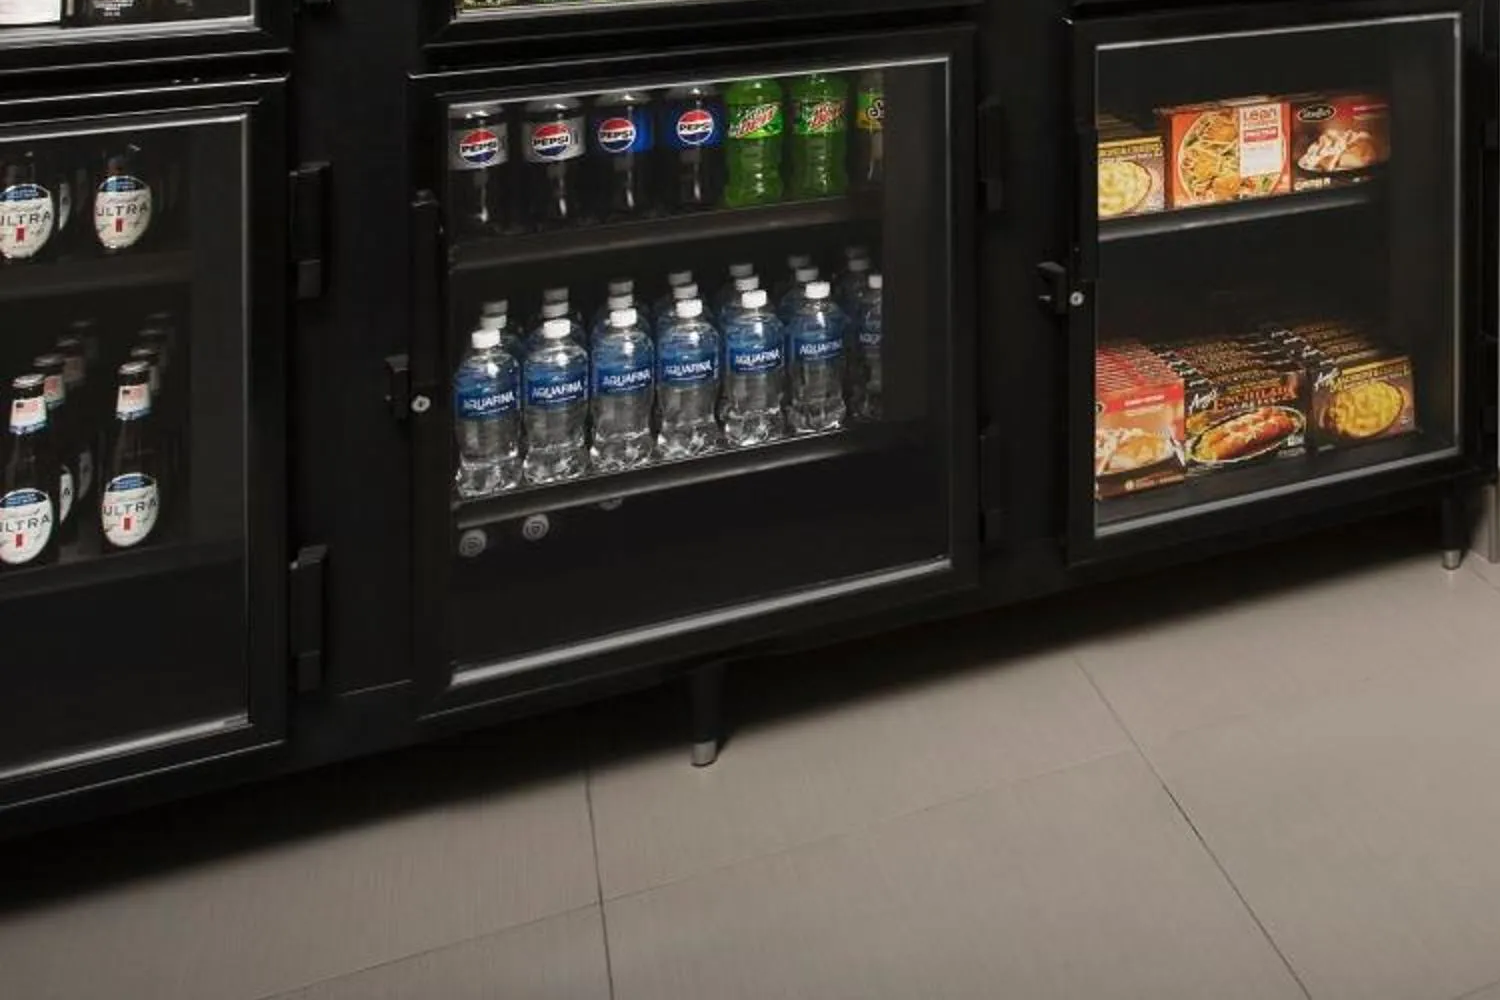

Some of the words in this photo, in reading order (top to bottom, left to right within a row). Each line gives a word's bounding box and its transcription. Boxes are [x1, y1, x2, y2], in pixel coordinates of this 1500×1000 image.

[533, 135, 569, 147] PEPSI
[96, 201, 148, 217] ULTRA
[800, 340, 843, 355] AQUAFINA
[735, 348, 781, 366] AQUAFINA
[665, 359, 712, 376] AQUAFINA
[602, 368, 651, 388] AQUAFINA
[531, 380, 583, 399] AQUAFINA
[463, 391, 515, 411] AQUAFINA
[103, 500, 158, 516] ULTRA
